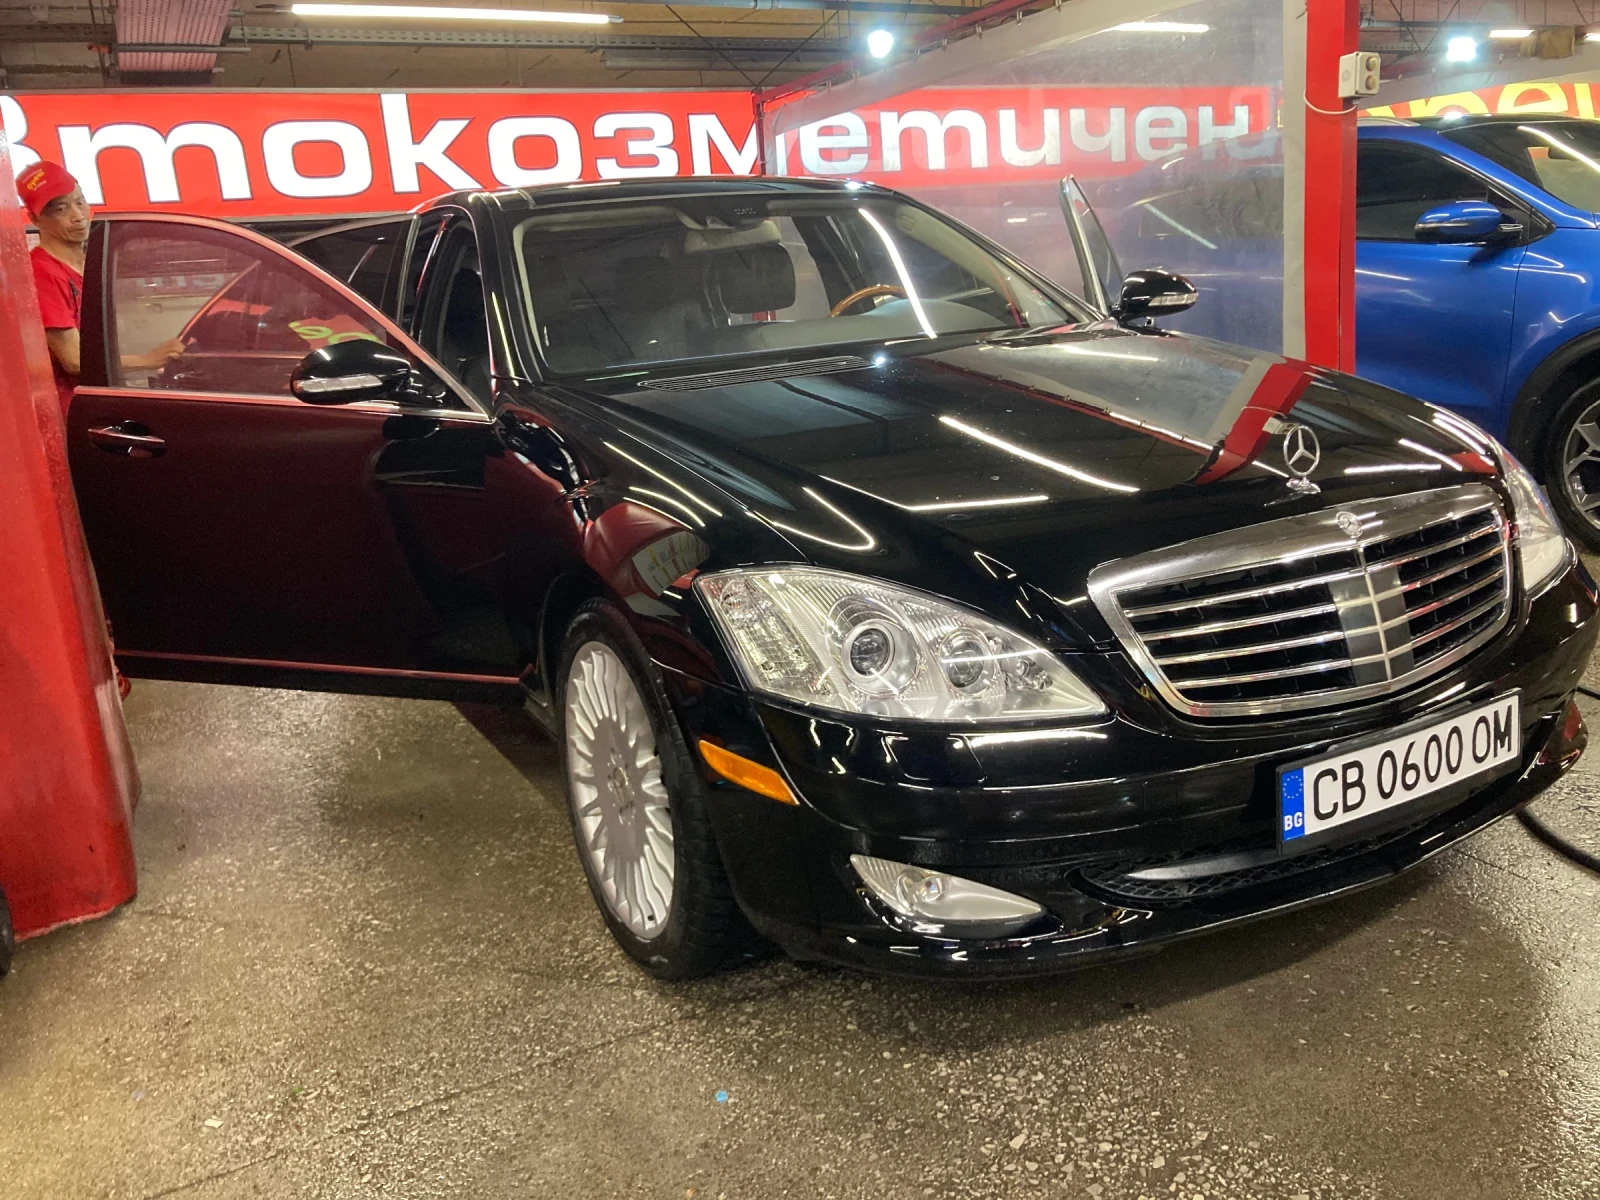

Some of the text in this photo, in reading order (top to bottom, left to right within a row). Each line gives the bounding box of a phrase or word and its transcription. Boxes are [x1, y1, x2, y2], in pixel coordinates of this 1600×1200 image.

[1313, 704, 1512, 821] CB 0600 OM
[1283, 811, 1303, 831] BG
